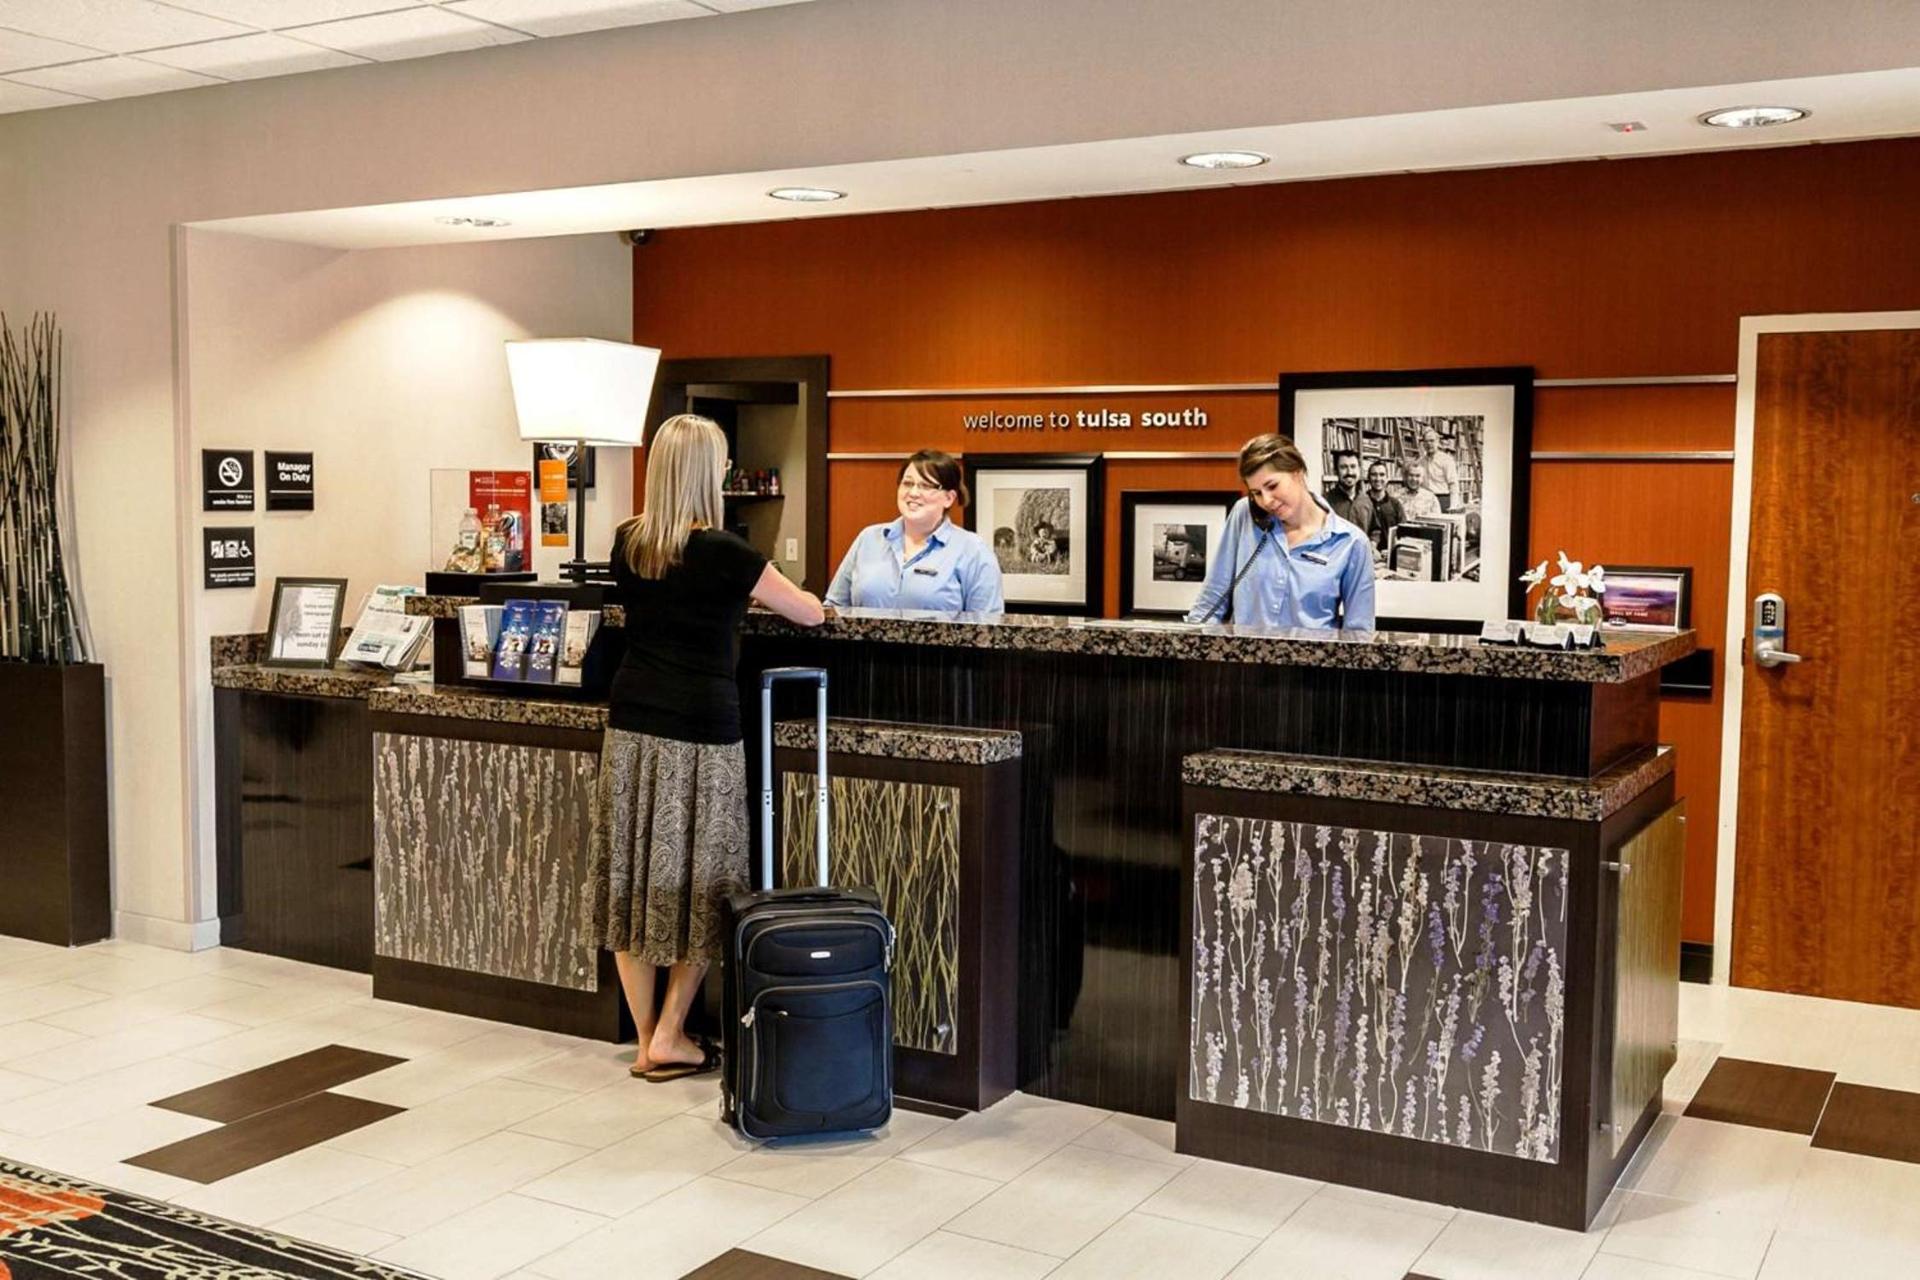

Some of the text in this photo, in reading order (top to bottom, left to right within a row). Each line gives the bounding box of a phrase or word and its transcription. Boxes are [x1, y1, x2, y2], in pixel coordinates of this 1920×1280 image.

[963, 408, 1207, 428] welcome to tulsa south
[277, 462, 310, 473] Manager
[279, 472, 310, 483] On Duty
